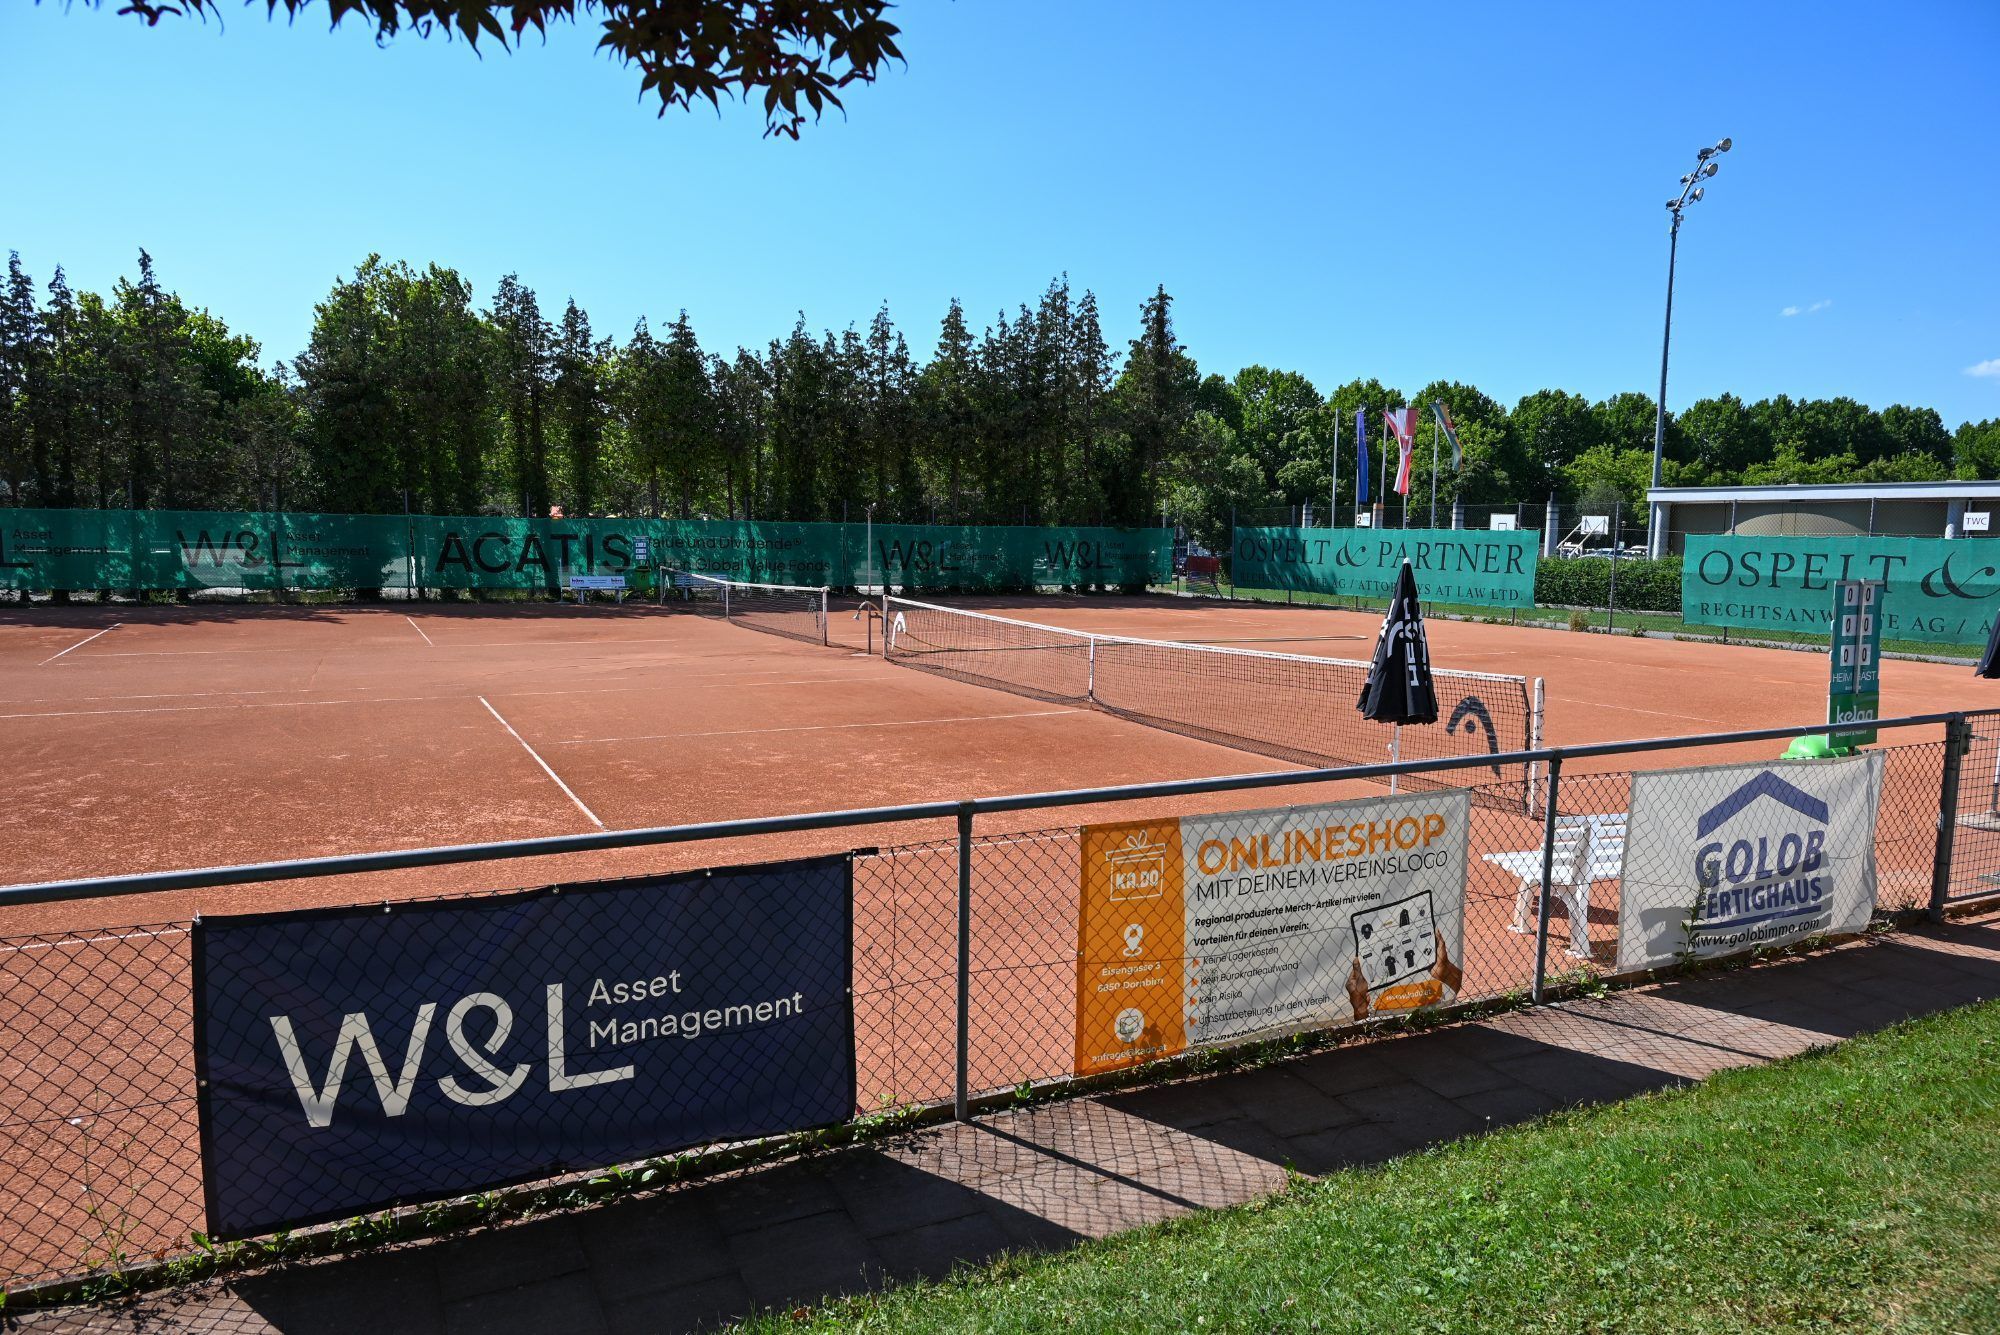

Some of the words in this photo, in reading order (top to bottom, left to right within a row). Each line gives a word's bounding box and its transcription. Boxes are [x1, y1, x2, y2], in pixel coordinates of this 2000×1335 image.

[1965, 517, 1988, 525] TWC
[13, 528, 54, 540] Asset
[286, 531, 321, 542] Asset
[649, 537, 685, 549] alue
[687, 536, 716, 549] und
[14, 543, 108, 557] Management
[175, 529, 305, 568] W&L
[286, 545, 369, 557] Management
[435, 532, 631, 573] ACATIS
[878, 540, 959, 571] W&L
[1045, 540, 1115, 570] W&L
[1240, 538, 1331, 565] OSPELT
[1335, 536, 1371, 567] &
[1376, 541, 1526, 575] PARTNER
[696, 558, 744, 572] Global
[750, 558, 785, 572] Value
[788, 559, 831, 572] Fonds
[1920, 550, 2000, 600] &
[1332, 578, 1346, 589] AG
[1358, 580, 1431, 594] ATTORYS
[1435, 585, 1453, 597] AT
[1457, 586, 1486, 599] LAW
[1491, 588, 1524, 601] LTD.
[1847, 587, 1853, 602] 0
[1865, 587, 1871, 602] 0
[1845, 618, 1851, 633] 0
[1863, 617, 1869, 632] 0
[1911, 616, 1946, 633] AG
[1843, 647, 1849, 662] 0
[1861, 647, 1867, 662] 0
[1832, 672, 1852, 683] HEIM
[1858, 671, 1877, 681] AST
[1197, 813, 1446, 875] ONLINESHOP
[1695, 830, 1825, 887] GOLOB
[1196, 879, 1233, 902] MIT
[1238, 869, 1315, 896] DEINEM
[1321, 850, 1448, 883] VEREINSLOGO
[1697, 876, 1822, 919] FERTIGHAUS
[1195, 912, 1234, 929] Regional
[1234, 907, 1284, 924] produzierte
[1284, 898, 1342, 914] Merch-Artikel
[1342, 895, 1356, 905] mit
[1356, 891, 1381, 902] vielen
[1193, 932, 1234, 947] Vorteilen
[1235, 930, 1249, 942] für
[1249, 925, 1279, 939] deinen
[1280, 921, 1309, 934] Verein:
[1690, 918, 1820, 948] www.golobimmo.com
[1203, 954, 1227, 966] Keine
[1228, 946, 1279, 962] Lagerkosten
[1101, 963, 1154, 976] Eisengasse
[587, 968, 682, 1007] Asset
[1097, 982, 1120, 993] 6850
[1122, 977, 1164, 989] Dornbirn
[1199, 994, 1217, 1005] Kein
[1219, 991, 1242, 1001] Risiko
[1286, 999, 1303, 1010] den
[1304, 994, 1330, 1007] Verein
[590, 990, 804, 1049] Management
[269, 982, 635, 1128] W&L
